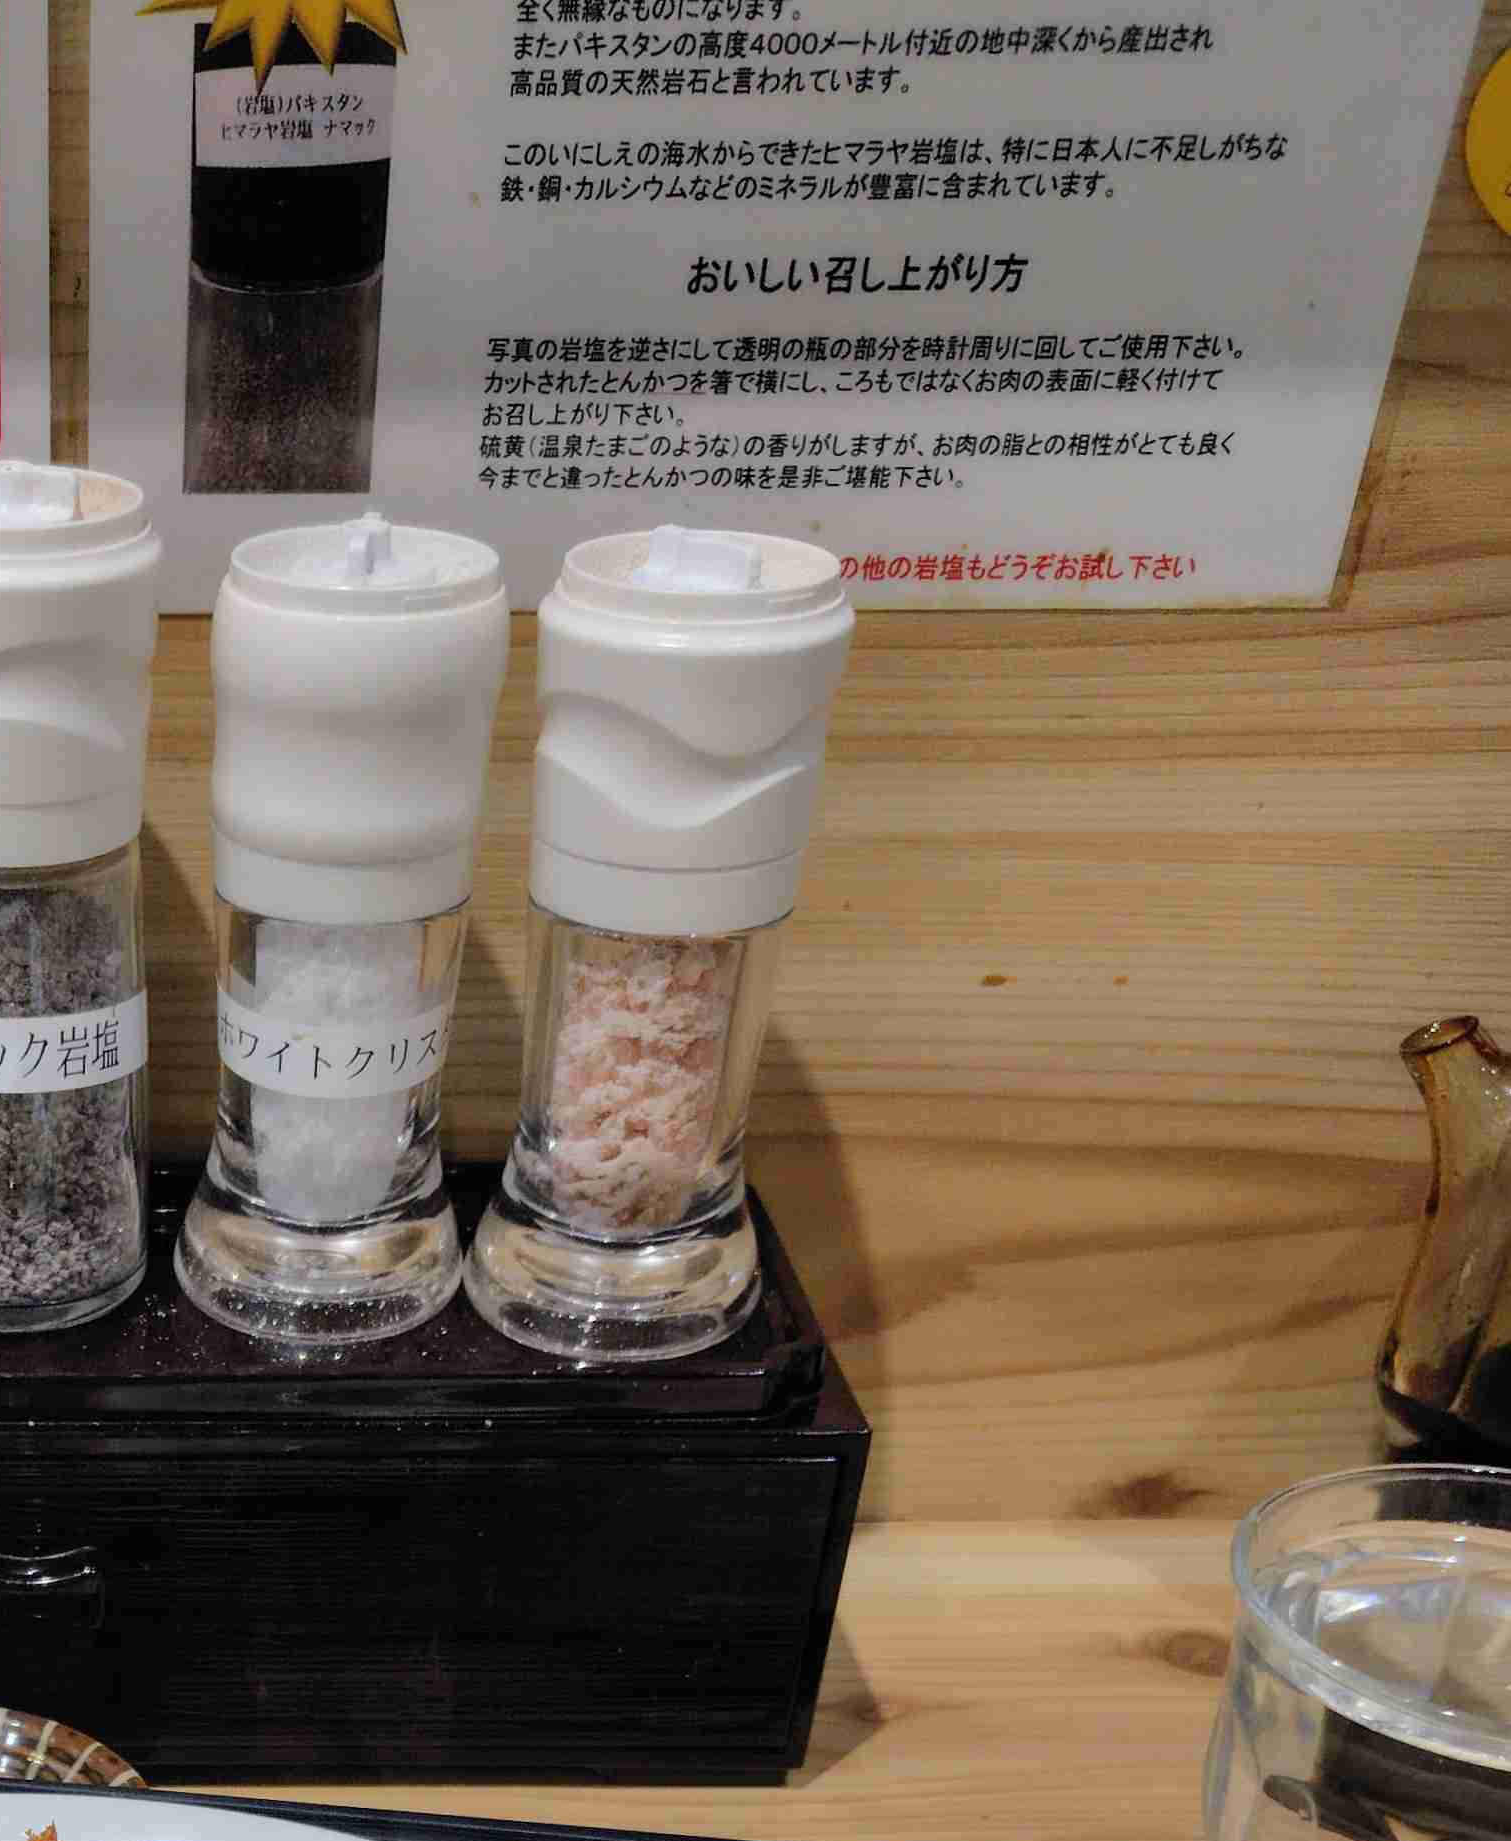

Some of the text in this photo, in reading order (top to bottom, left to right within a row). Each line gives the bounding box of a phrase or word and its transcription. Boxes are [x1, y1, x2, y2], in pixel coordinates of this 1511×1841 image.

[687, 252, 1029, 294] おいしい召し上がり方
[481, 402, 687, 427] お召し上がり下さい。
